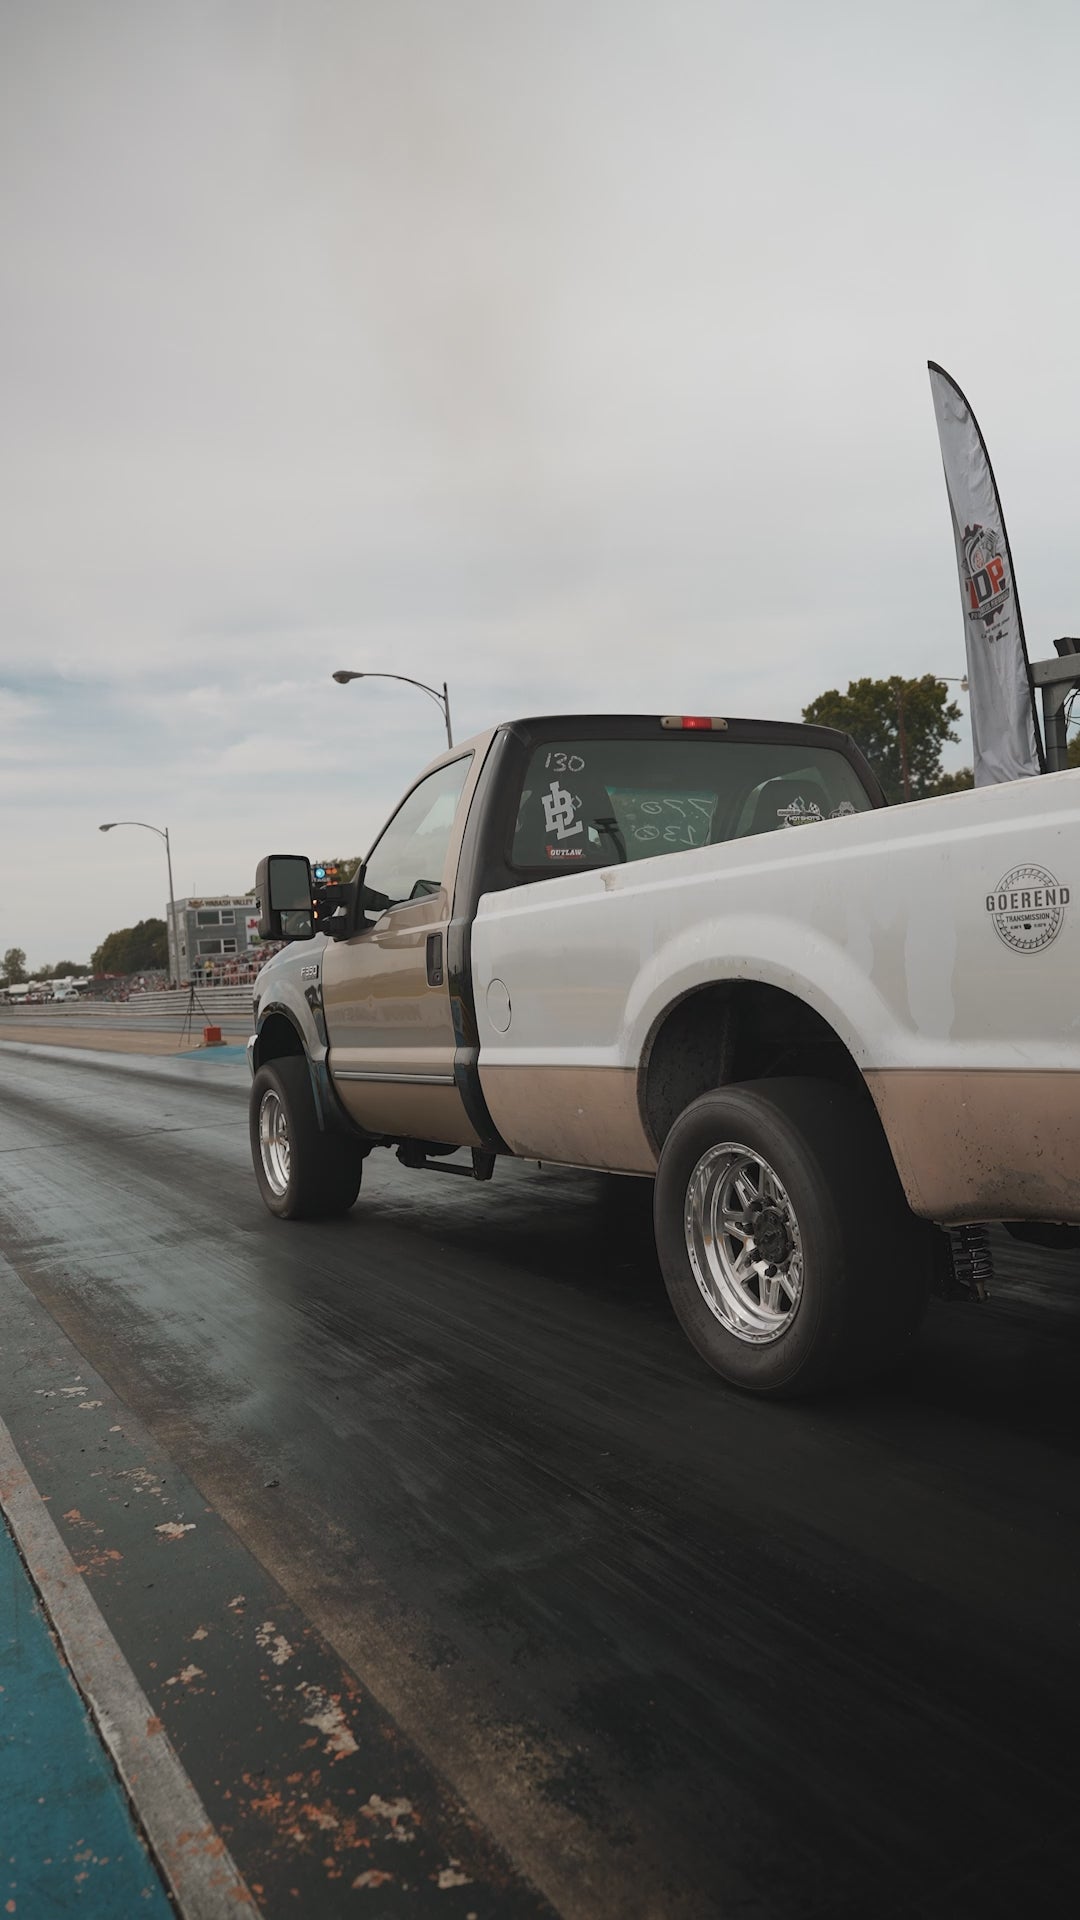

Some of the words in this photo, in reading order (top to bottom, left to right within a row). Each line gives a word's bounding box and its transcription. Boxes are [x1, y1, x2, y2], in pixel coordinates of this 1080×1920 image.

[545, 752, 585, 772] 130
[986, 888, 1070, 912] GOEREND
[1005, 912, 1050, 922] TRANSMISSION
